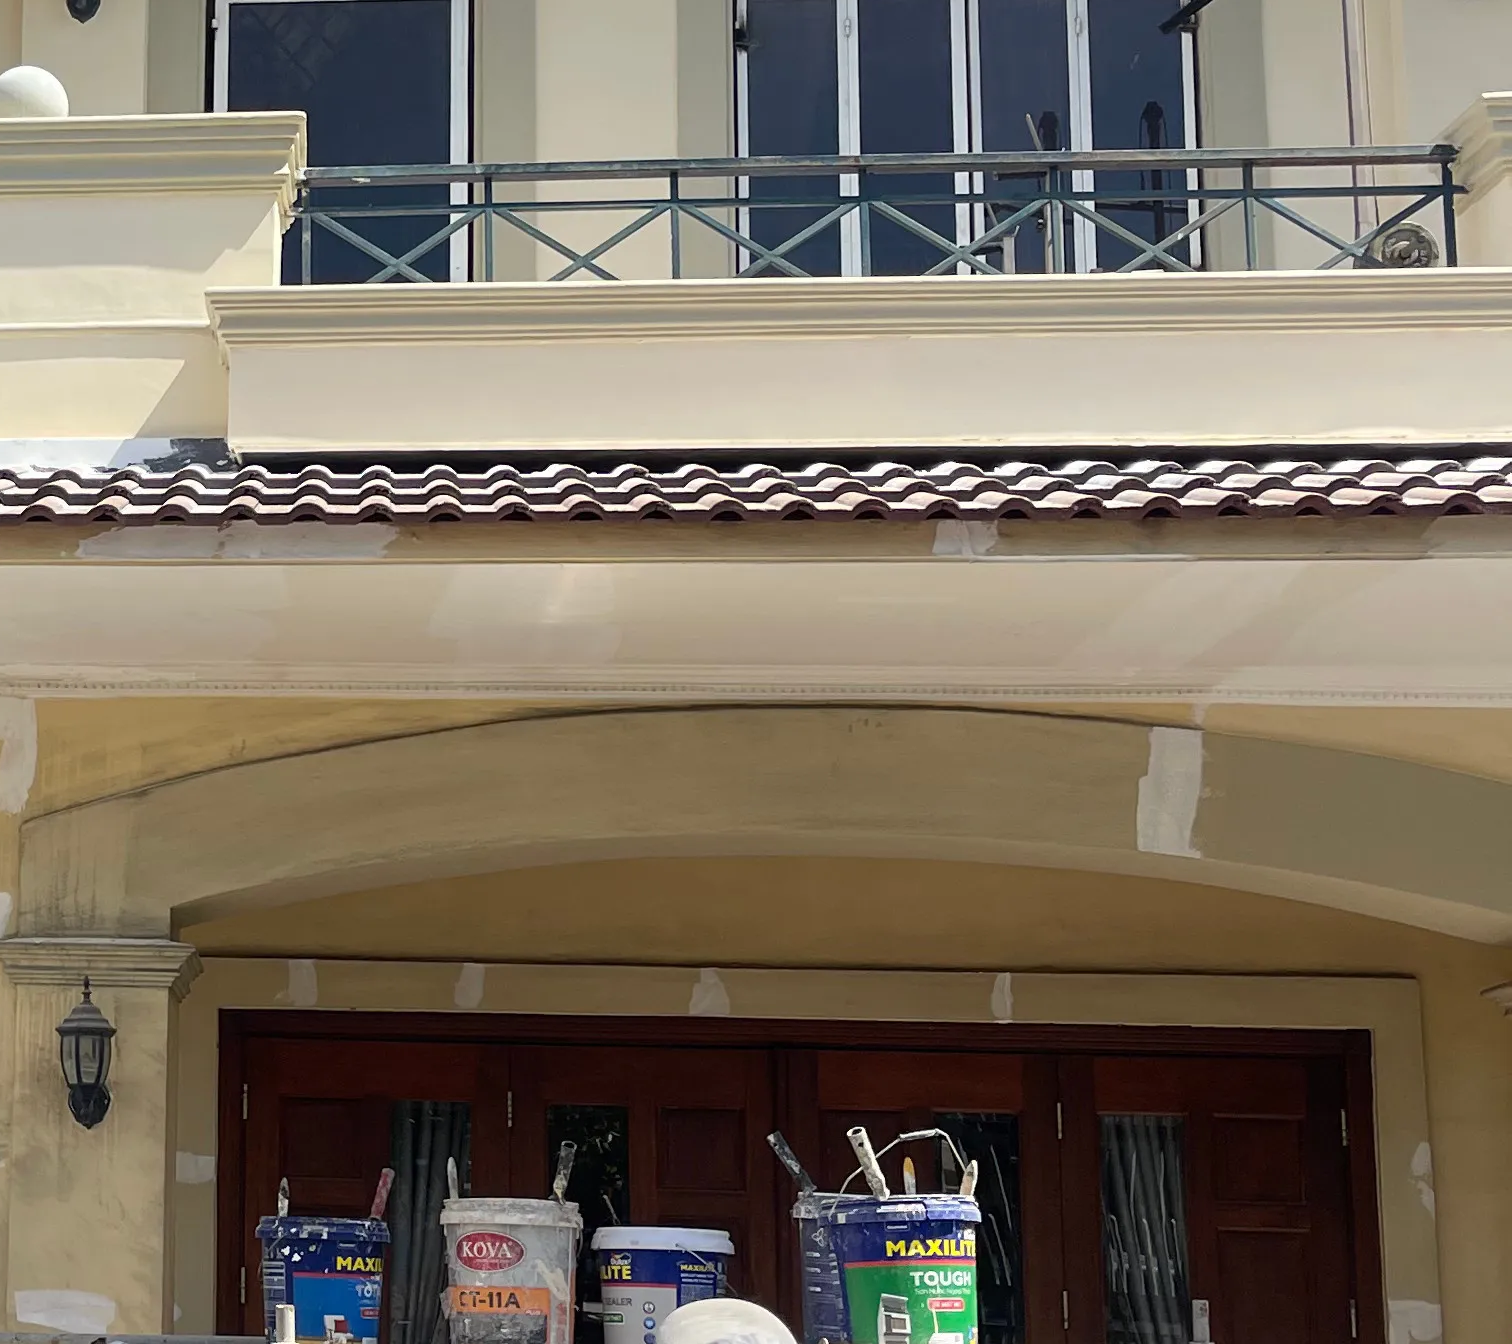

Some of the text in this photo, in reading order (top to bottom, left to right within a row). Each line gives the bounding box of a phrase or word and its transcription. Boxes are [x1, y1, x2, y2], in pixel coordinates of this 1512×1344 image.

[462, 1241, 513, 1258] KOVA
[336, 1256, 384, 1272] MAXIL
[600, 1265, 632, 1280] LITE
[909, 1270, 972, 1287] TOUGH
[458, 1290, 521, 1309] CT-11A
